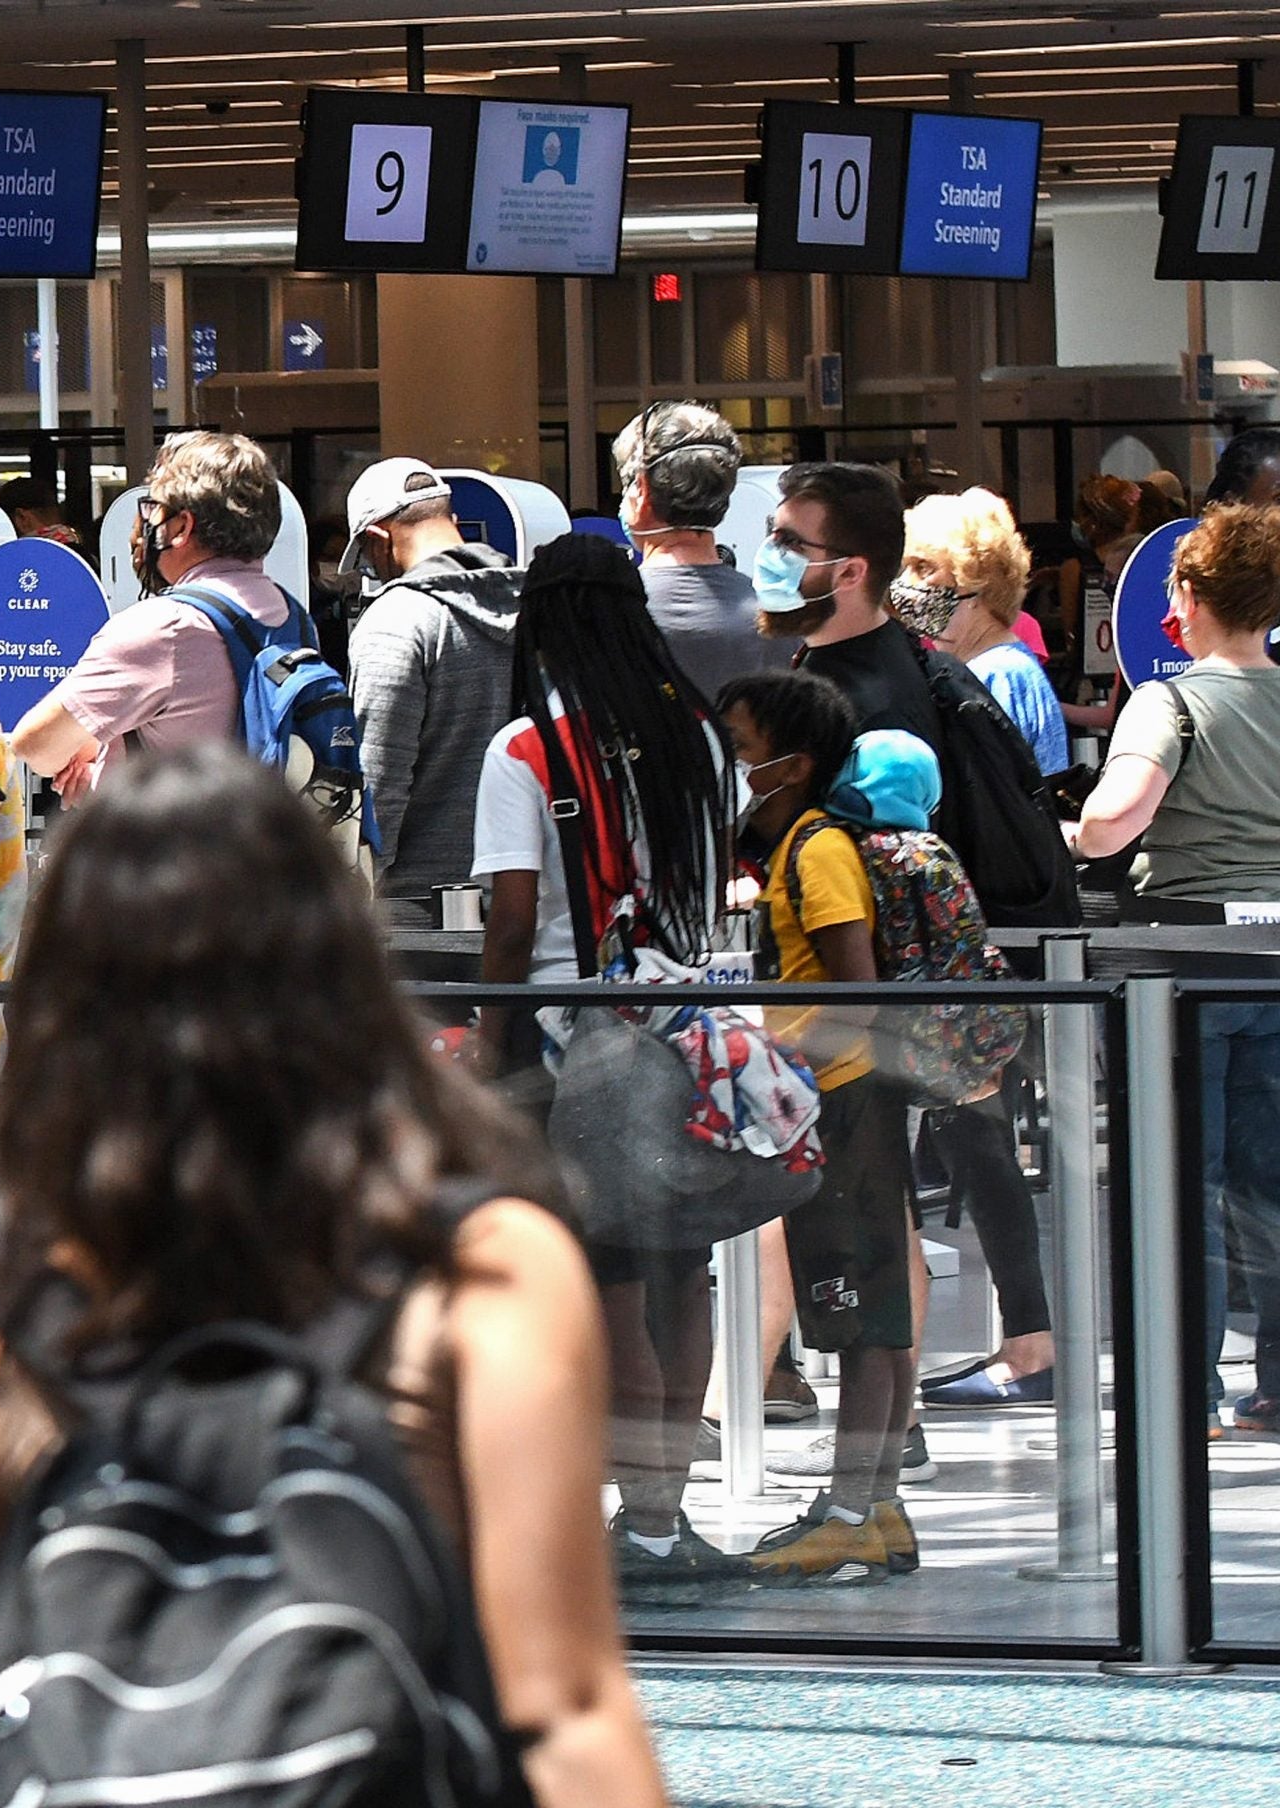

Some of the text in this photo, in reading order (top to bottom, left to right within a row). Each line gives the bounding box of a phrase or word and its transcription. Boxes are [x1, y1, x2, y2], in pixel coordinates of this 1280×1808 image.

[3, 127, 36, 154] TSA
[960, 145, 987, 171] TSA
[374, 150, 406, 216] 9
[807, 157, 862, 221] 10
[939, 182, 1002, 209] Standard
[1213, 170, 1258, 229] 11
[934, 218, 1001, 252] Screening
[7, 598, 49, 610] CLEAR
[28, 639, 62, 656] safe.
[9, 664, 43, 682] your
[1152, 658, 1160, 674] 1
